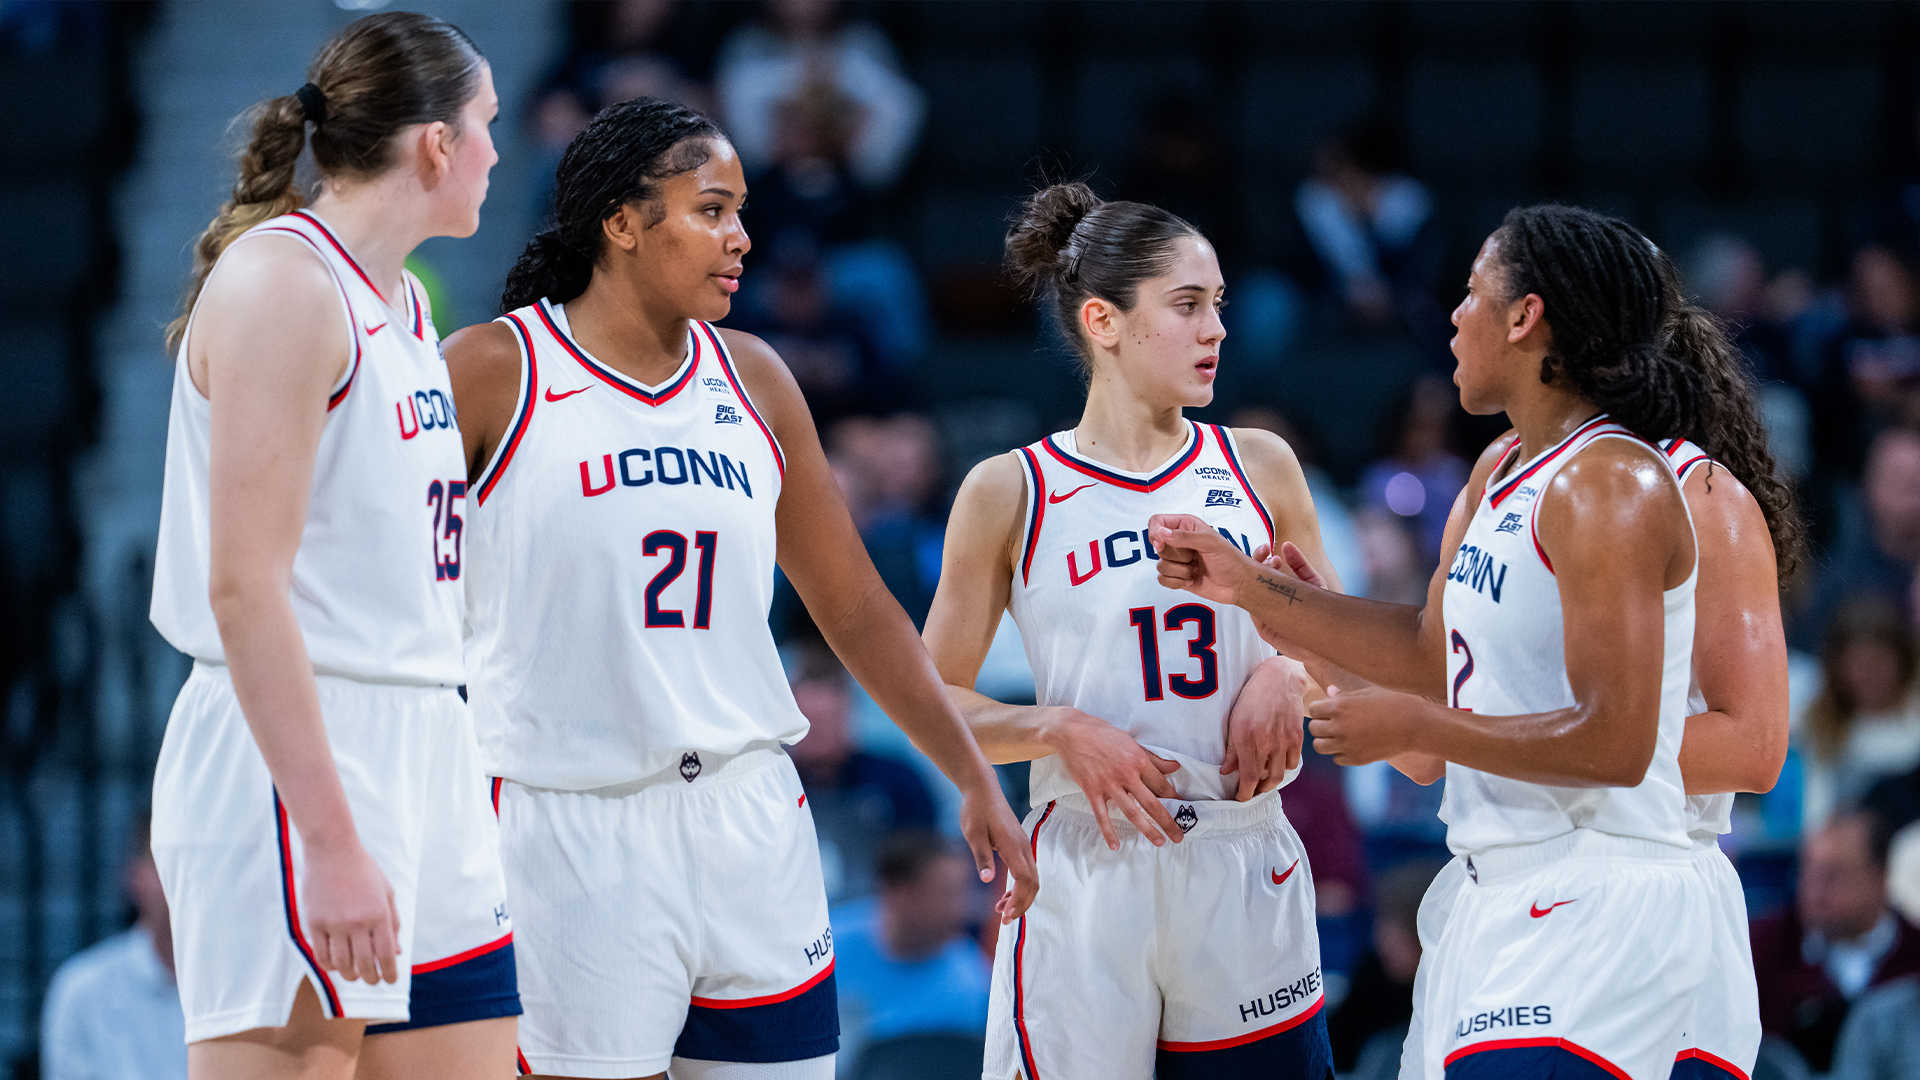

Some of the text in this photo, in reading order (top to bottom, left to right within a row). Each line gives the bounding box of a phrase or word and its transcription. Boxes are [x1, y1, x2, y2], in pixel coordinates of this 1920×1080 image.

[716, 404, 736, 415] BIG
[715, 412, 743, 423] EAST
[579, 446, 753, 499] UCONN
[1194, 466, 1232, 477] UCONN
[1201, 474, 1231, 482] HEALTH
[1207, 489, 1234, 498] BIG
[1205, 496, 1243, 506] EAST
[427, 479, 468, 581] 25
[642, 529, 718, 630] 21
[1129, 602, 1219, 702] 13
[1450, 628, 1474, 713] 2
